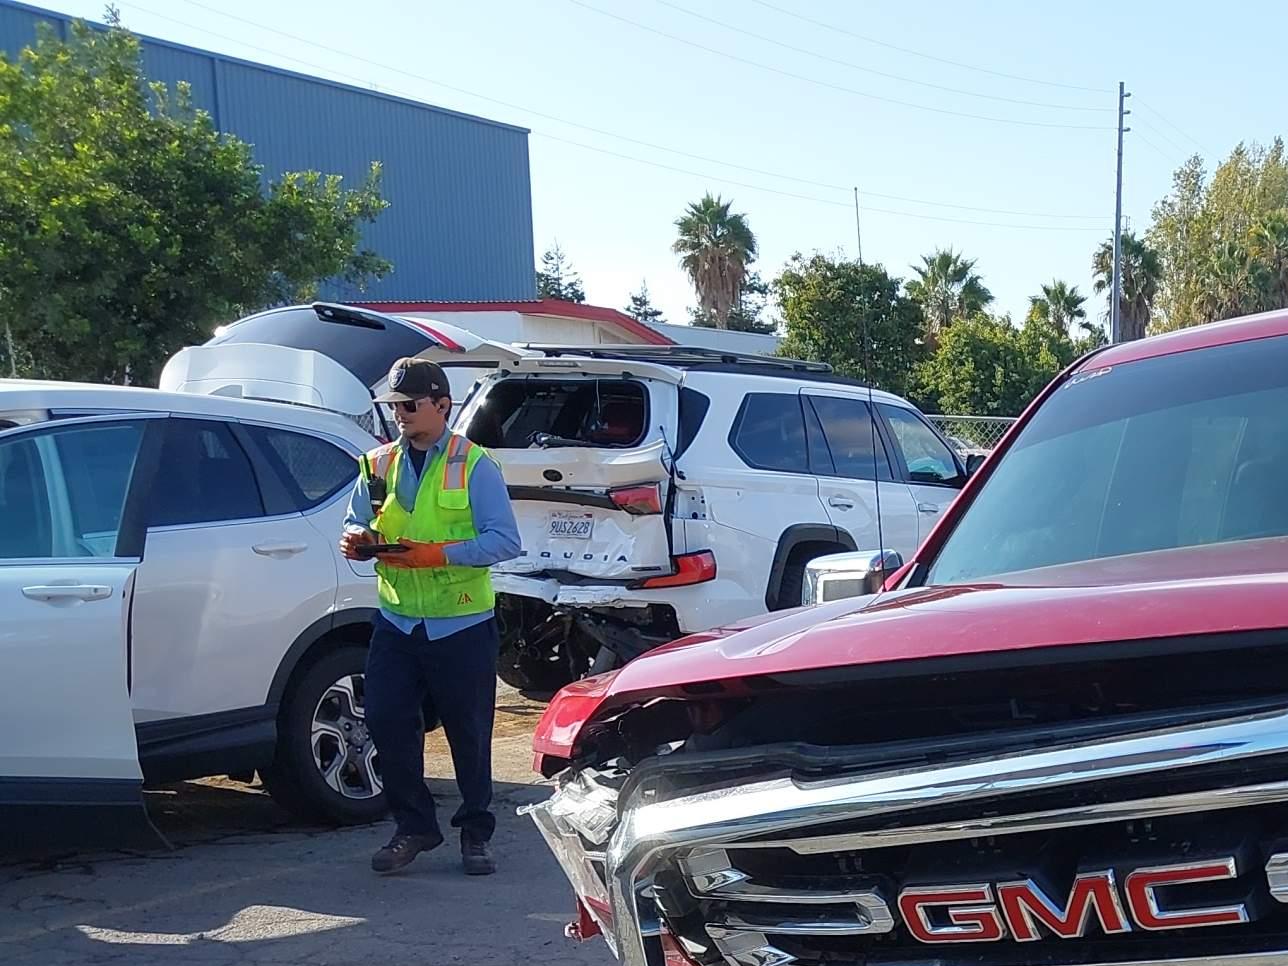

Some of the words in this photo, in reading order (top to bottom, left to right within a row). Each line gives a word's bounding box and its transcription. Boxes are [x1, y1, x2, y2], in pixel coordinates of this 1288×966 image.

[549, 520, 590, 534] 9USZ628
[519, 550, 628, 562] EQUOIA
[898, 856, 1250, 943] GMC
